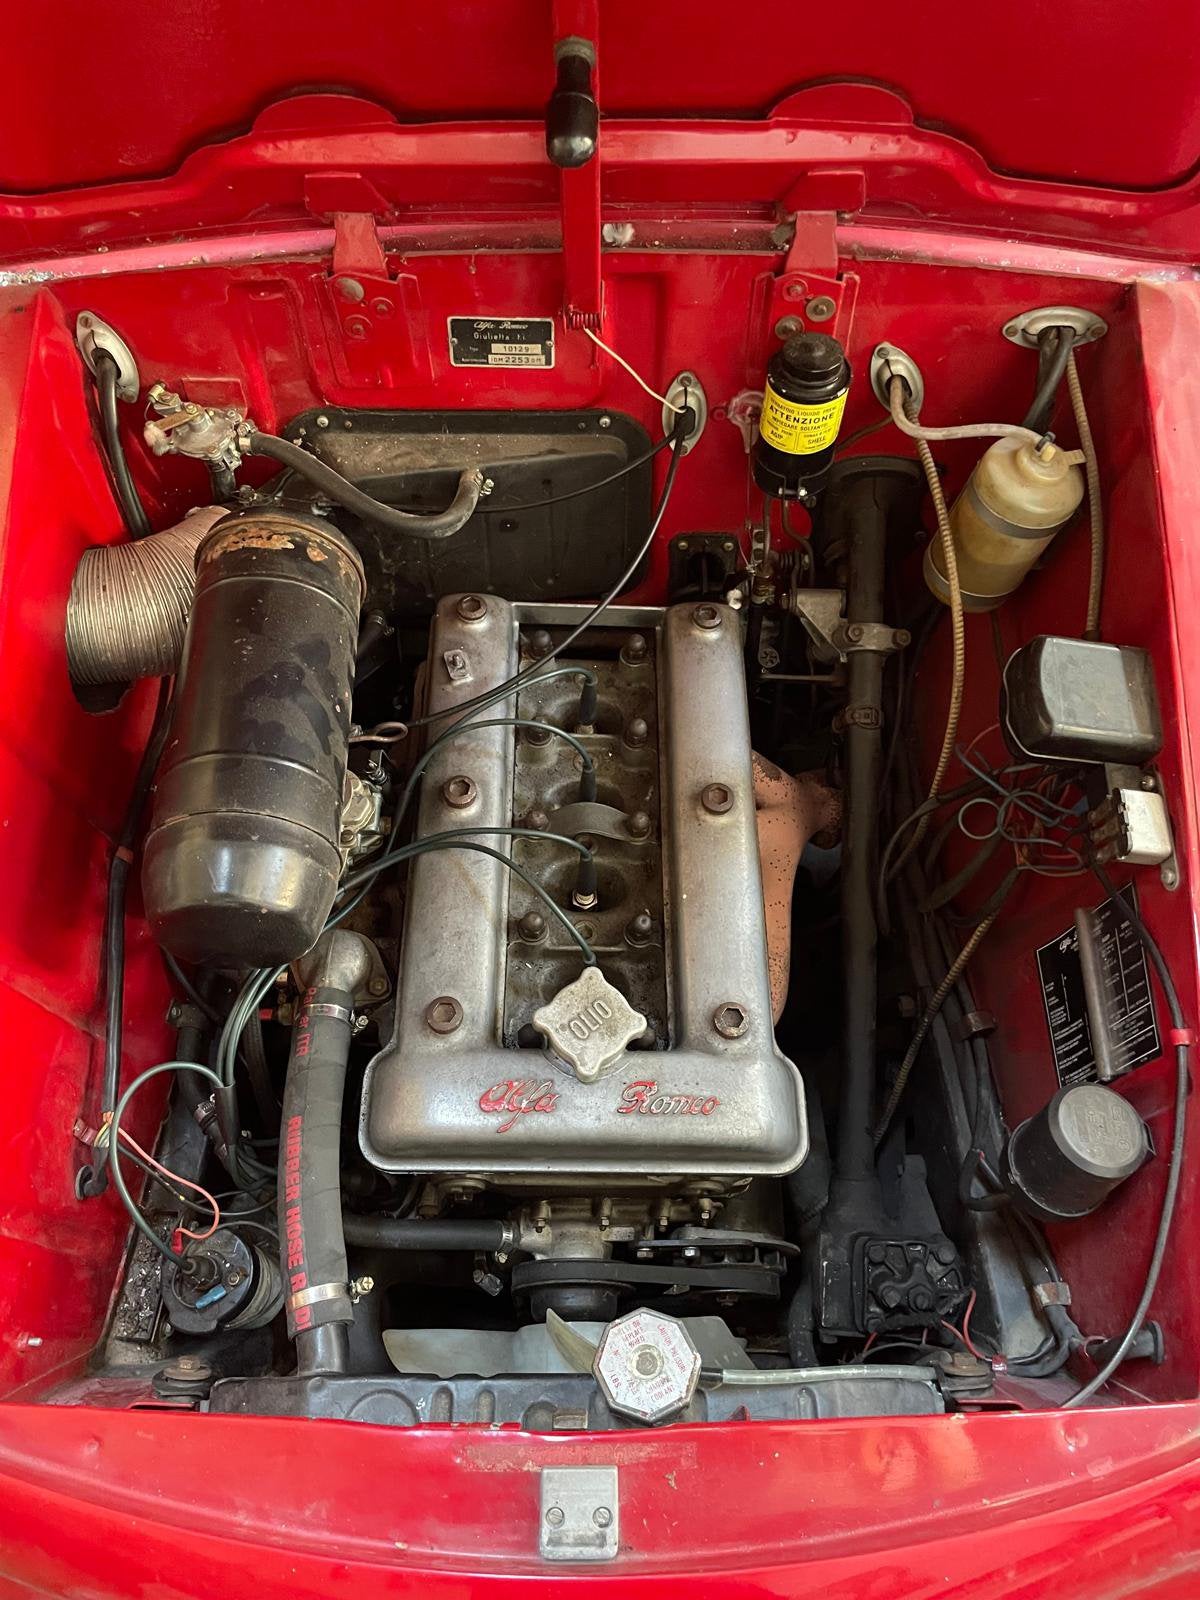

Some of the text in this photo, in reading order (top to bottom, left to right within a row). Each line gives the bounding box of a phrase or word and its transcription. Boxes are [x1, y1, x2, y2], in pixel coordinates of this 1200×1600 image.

[473, 332, 510, 340] Giulietta
[474, 321, 495, 331] Alfa
[769, 405, 835, 424] ATTENZIONE
[569, 999, 613, 1040] OLIO
[478, 1079, 721, 1133] Alfa Romeo
[286, 1115, 313, 1331] RUBBER HOSE RDI
